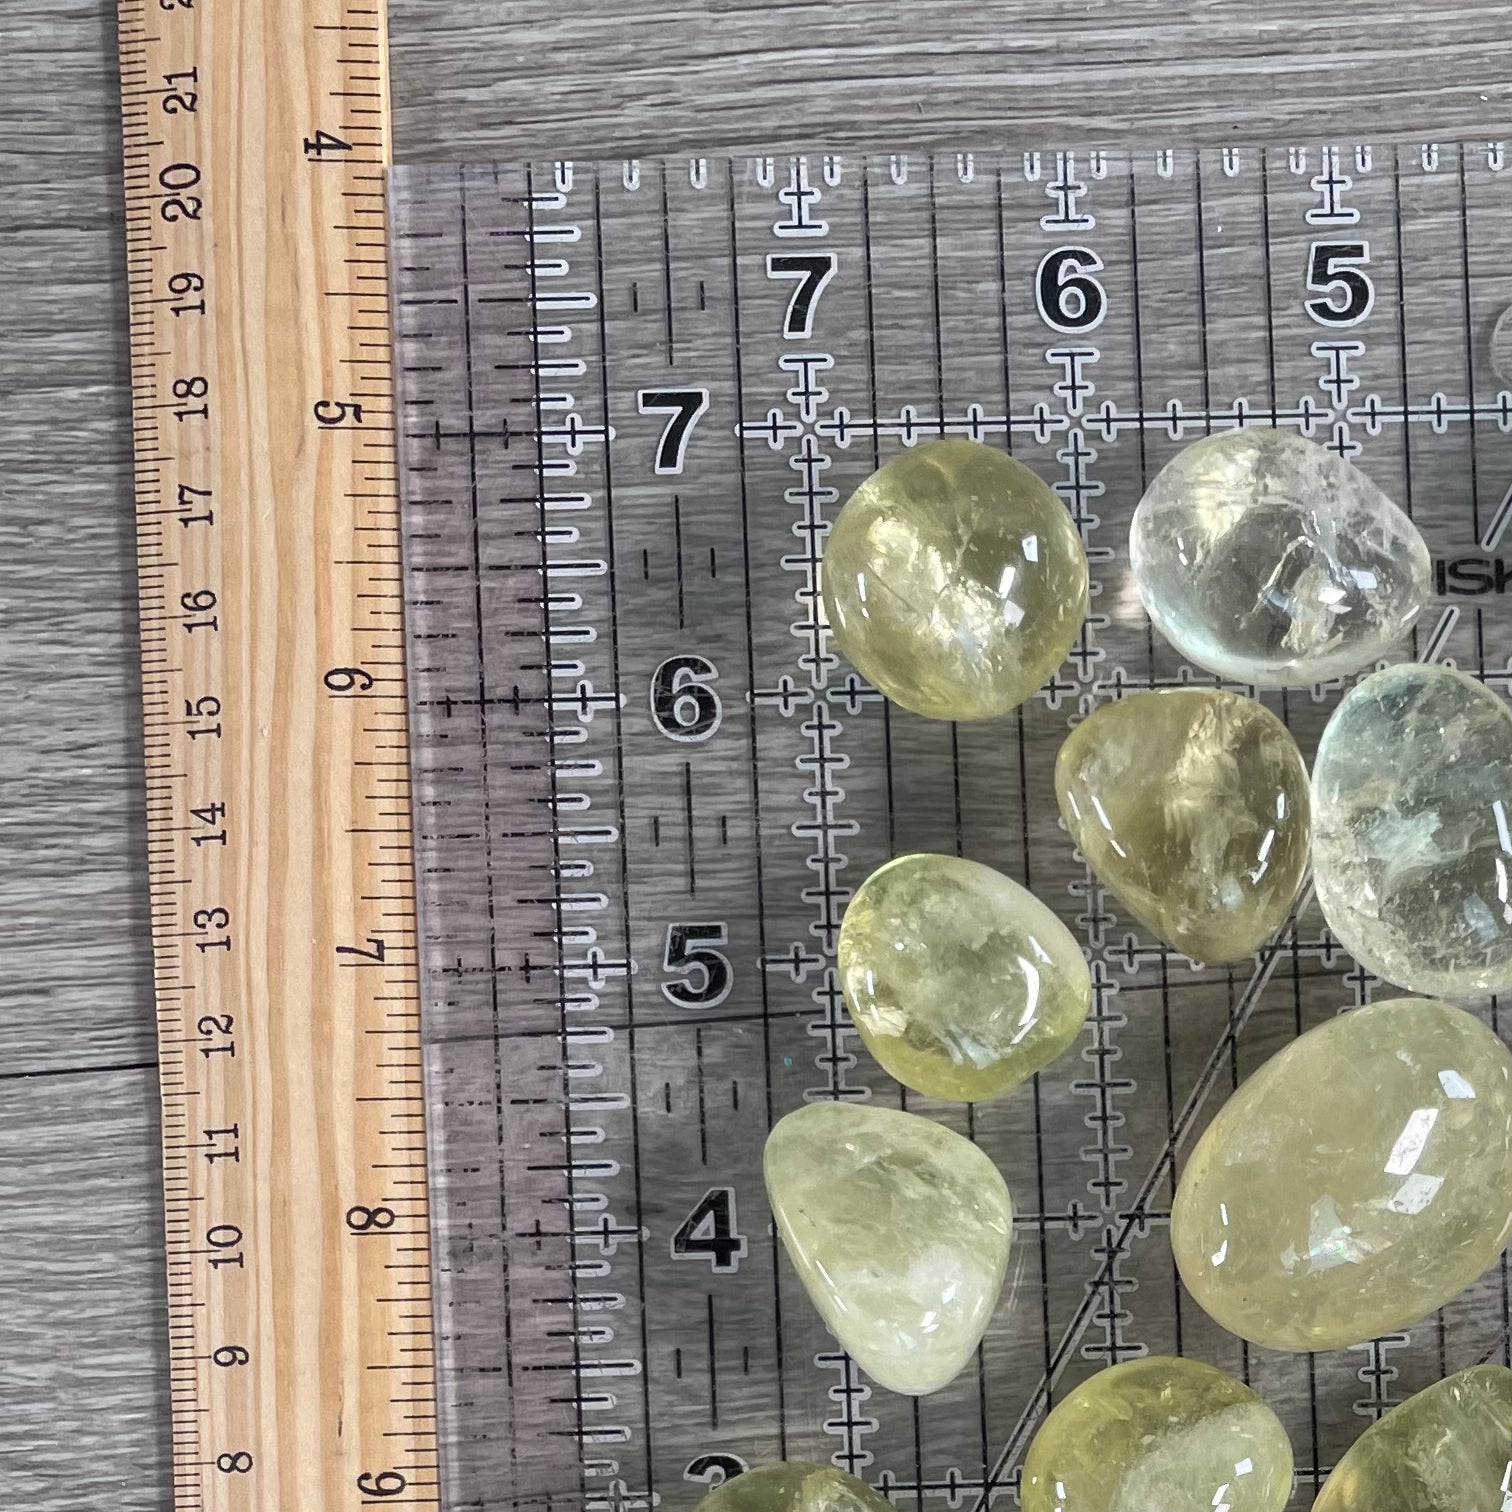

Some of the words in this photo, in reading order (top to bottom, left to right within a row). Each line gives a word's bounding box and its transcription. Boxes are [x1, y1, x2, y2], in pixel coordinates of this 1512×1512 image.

[162, 66, 199, 114] 21
[303, 131, 352, 156] 4
[159, 163, 202, 221] 20
[168, 272, 205, 316] 19
[767, 253, 837, 340] 7
[1035, 246, 1107, 333] 6
[1306, 240, 1375, 327] 5
[173, 376, 209, 421] 18
[314, 399, 363, 425] 5
[638, 388, 709, 474] 7
[177, 484, 213, 527] 17
[181, 590, 217, 633] 16
[324, 667, 374, 692] 6
[650, 655, 721, 742] 6
[186, 695, 222, 739] 15
[190, 802, 227, 846] 14
[194, 907, 230, 952] 13
[336, 939, 385, 963] 7
[661, 922, 732, 1010] 5
[198, 1014, 235, 1059] 12
[203, 1123, 240, 1163] 11
[347, 1206, 395, 1229] 8
[670, 1187, 748, 1274] 4
[207, 1225, 243, 1269] 10
[213, 1346, 249, 1367] 9
[217, 1452, 253, 1473] 8
[358, 1471, 406, 1497] 9
